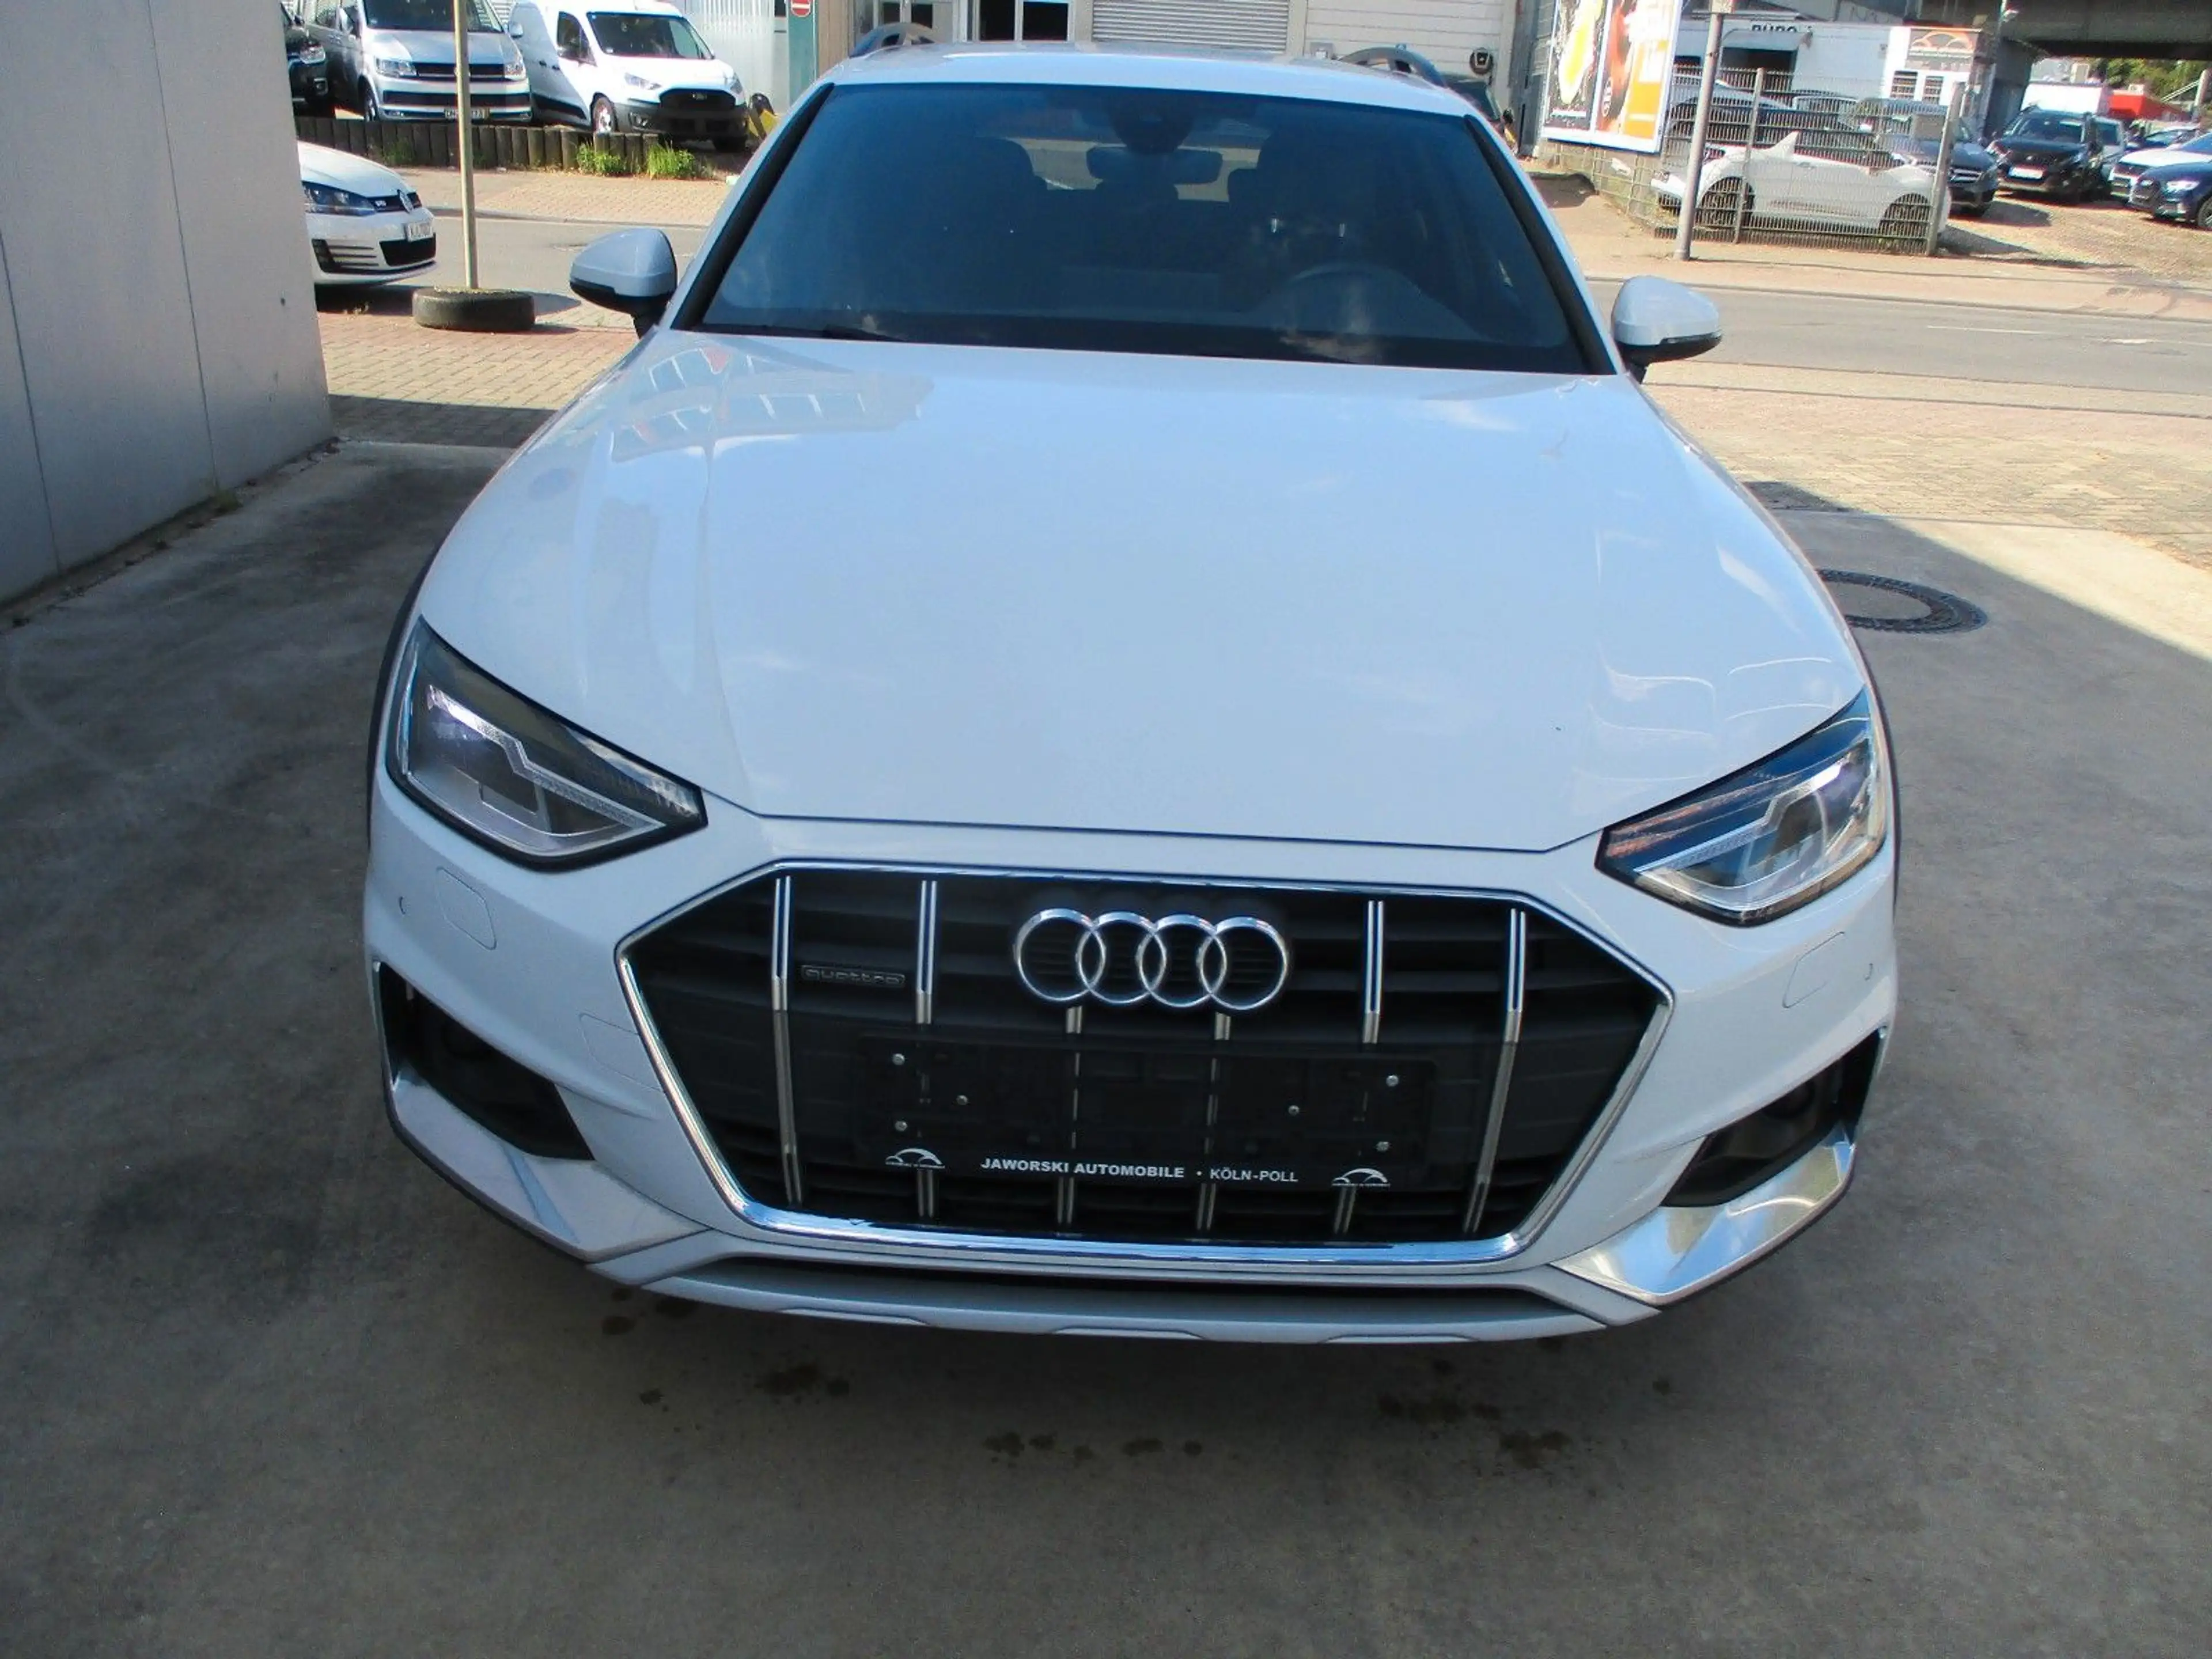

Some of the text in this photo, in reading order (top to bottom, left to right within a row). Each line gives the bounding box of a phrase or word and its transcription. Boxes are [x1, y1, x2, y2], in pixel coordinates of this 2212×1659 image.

[980, 1158, 1298, 1183] JAWORSKI AUTOMOBILE KÖLN-POLL
